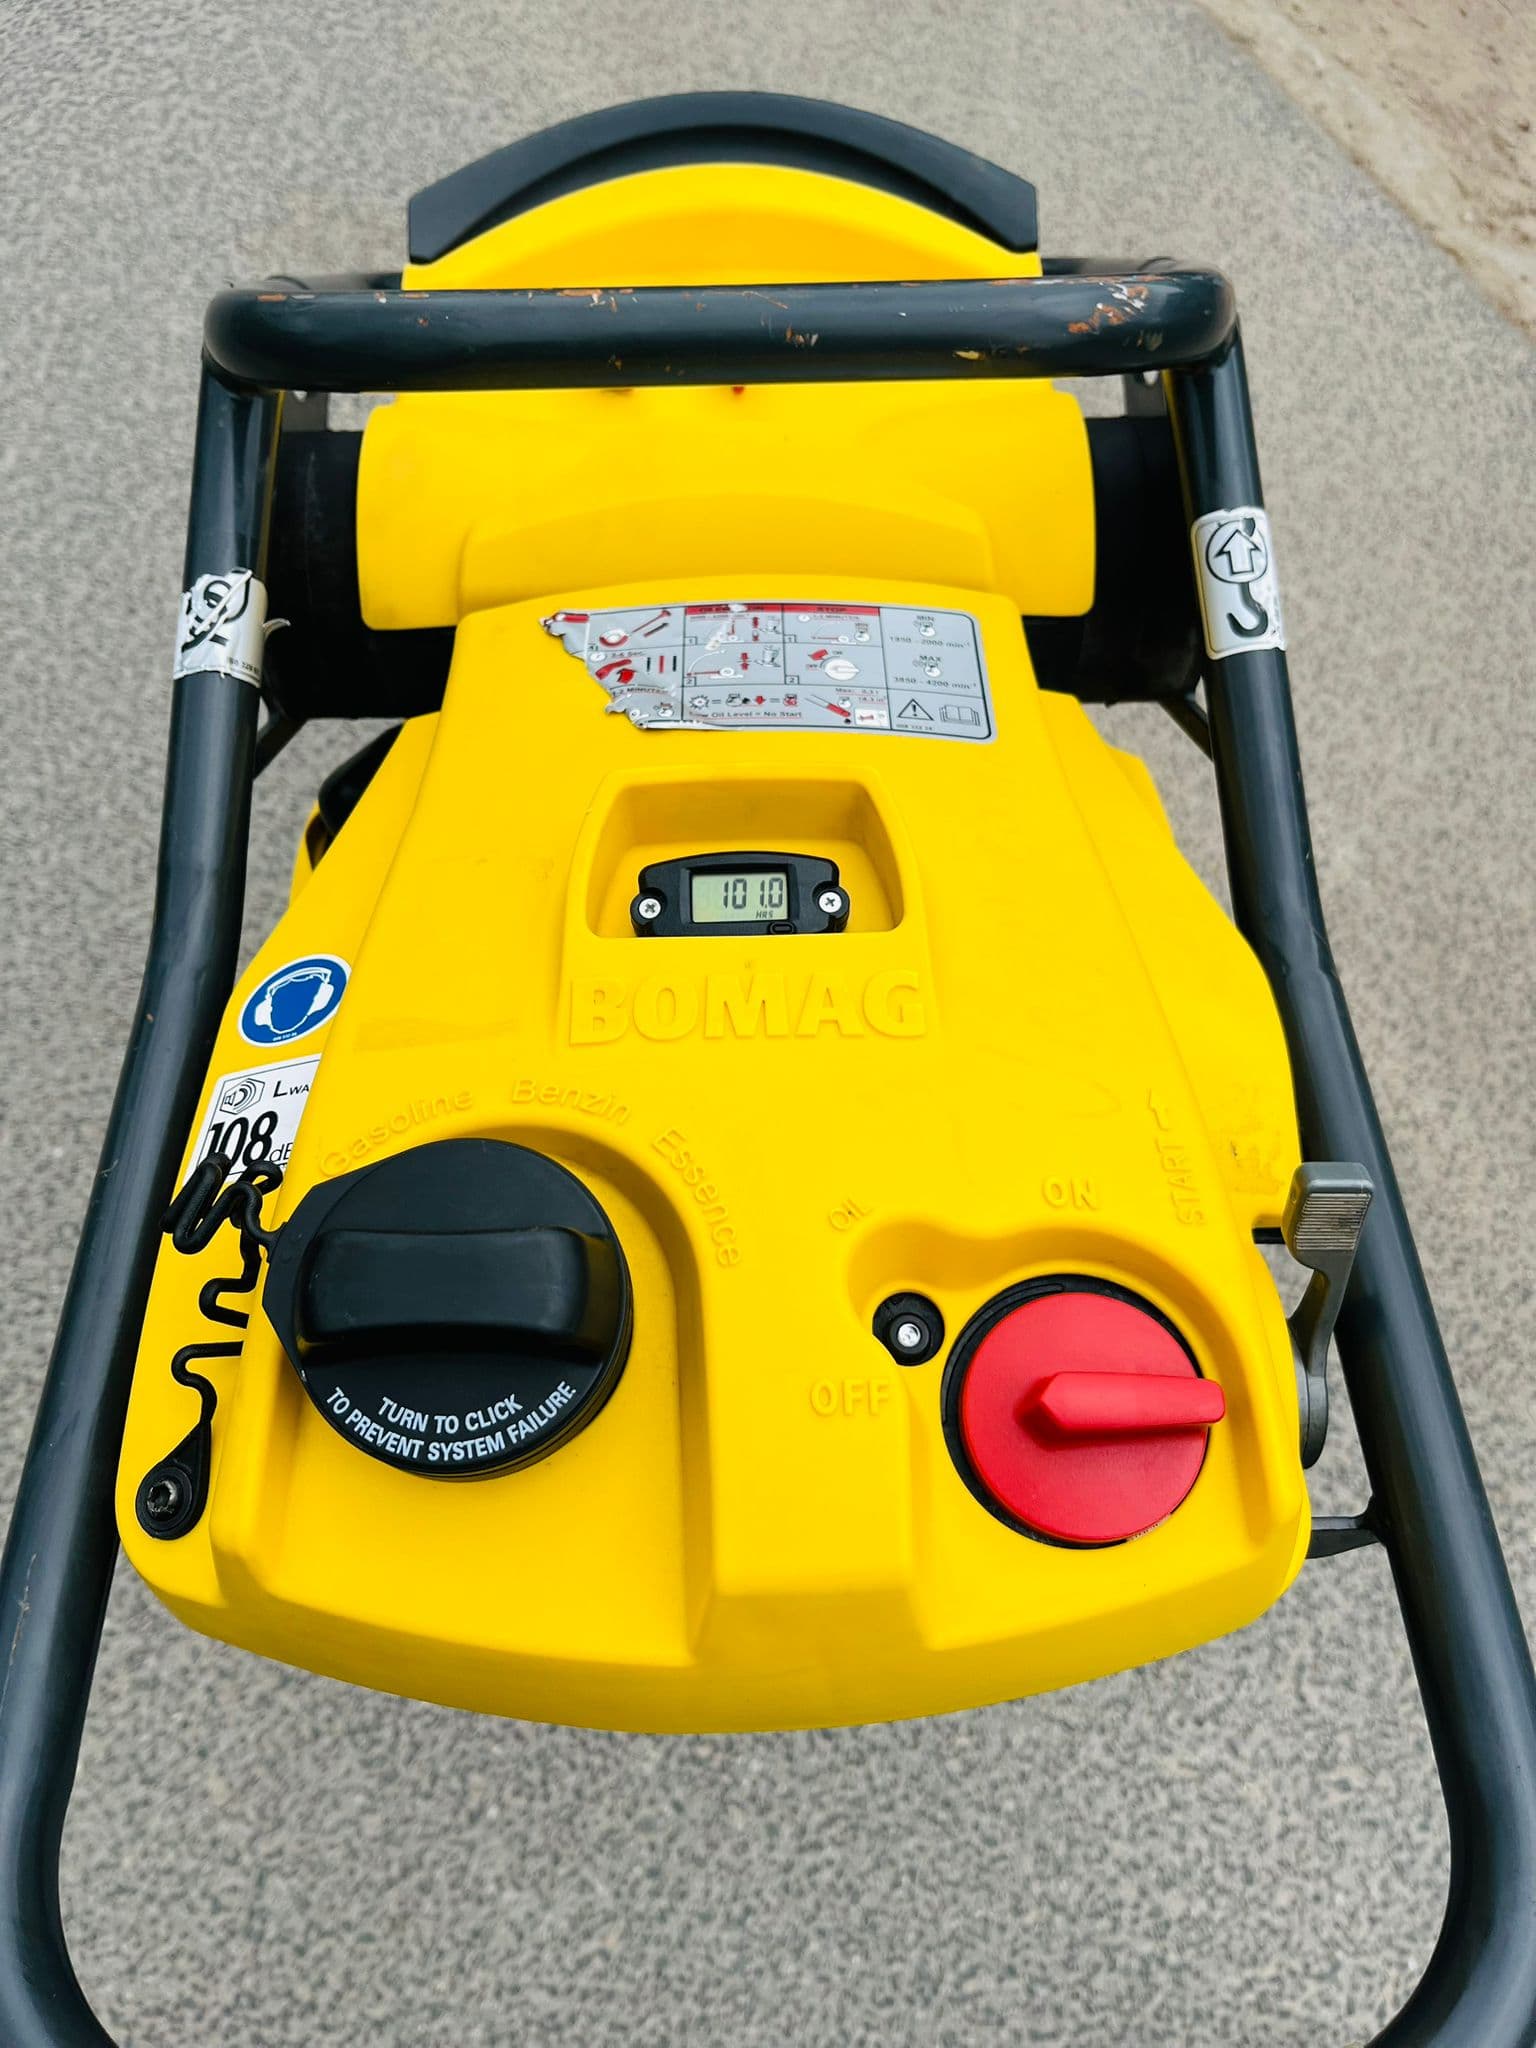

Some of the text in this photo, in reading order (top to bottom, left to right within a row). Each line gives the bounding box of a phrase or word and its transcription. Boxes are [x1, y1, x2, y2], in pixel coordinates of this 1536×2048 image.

[723, 877, 784, 910] 101.0
[755, 910, 774, 919] HRS
[569, 969, 927, 1047] BOMAG
[511, 1078, 633, 1125] Benzin
[208, 1110, 279, 1171] 108
[319, 1089, 474, 1179] Gasoline
[652, 1127, 742, 1268] Essence
[1042, 1176, 1098, 1211] ON
[1154, 1136, 1207, 1227] START
[326, 1387, 351, 1415] TO
[345, 1408, 424, 1459] PREVENT
[427, 1431, 506, 1461] SYSTEM
[377, 1394, 523, 1434] TURN TO CLICK
[810, 1377, 890, 1417] OFF
